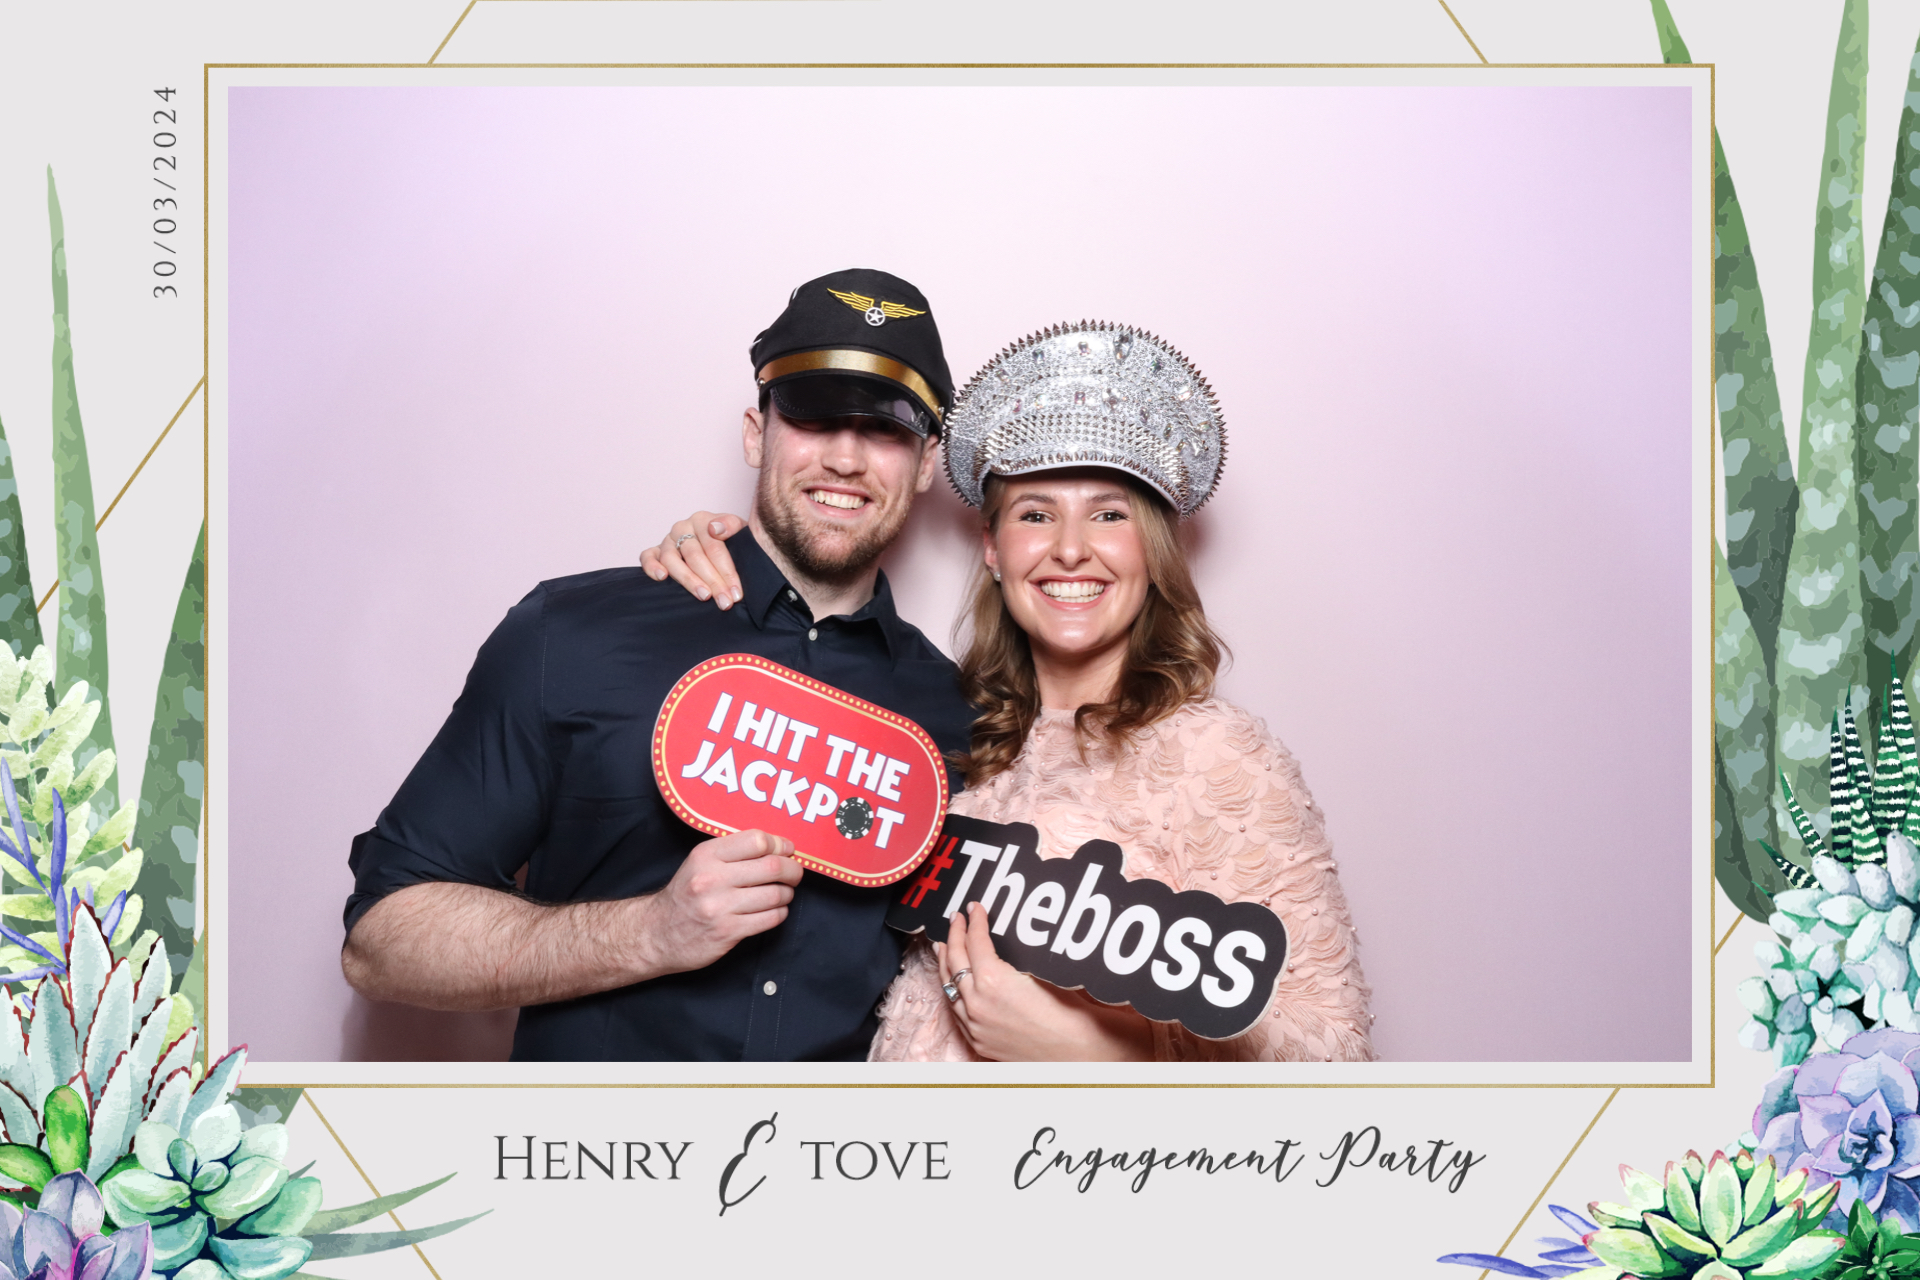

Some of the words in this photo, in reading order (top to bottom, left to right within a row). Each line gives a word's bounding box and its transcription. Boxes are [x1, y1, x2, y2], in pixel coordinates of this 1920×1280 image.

[681, 739, 906, 850] JACKPOT
[707, 691, 734, 734] I
[733, 700, 819, 763] HIT
[825, 734, 911, 803] THE
[900, 834, 1266, 1008] #Theboss
